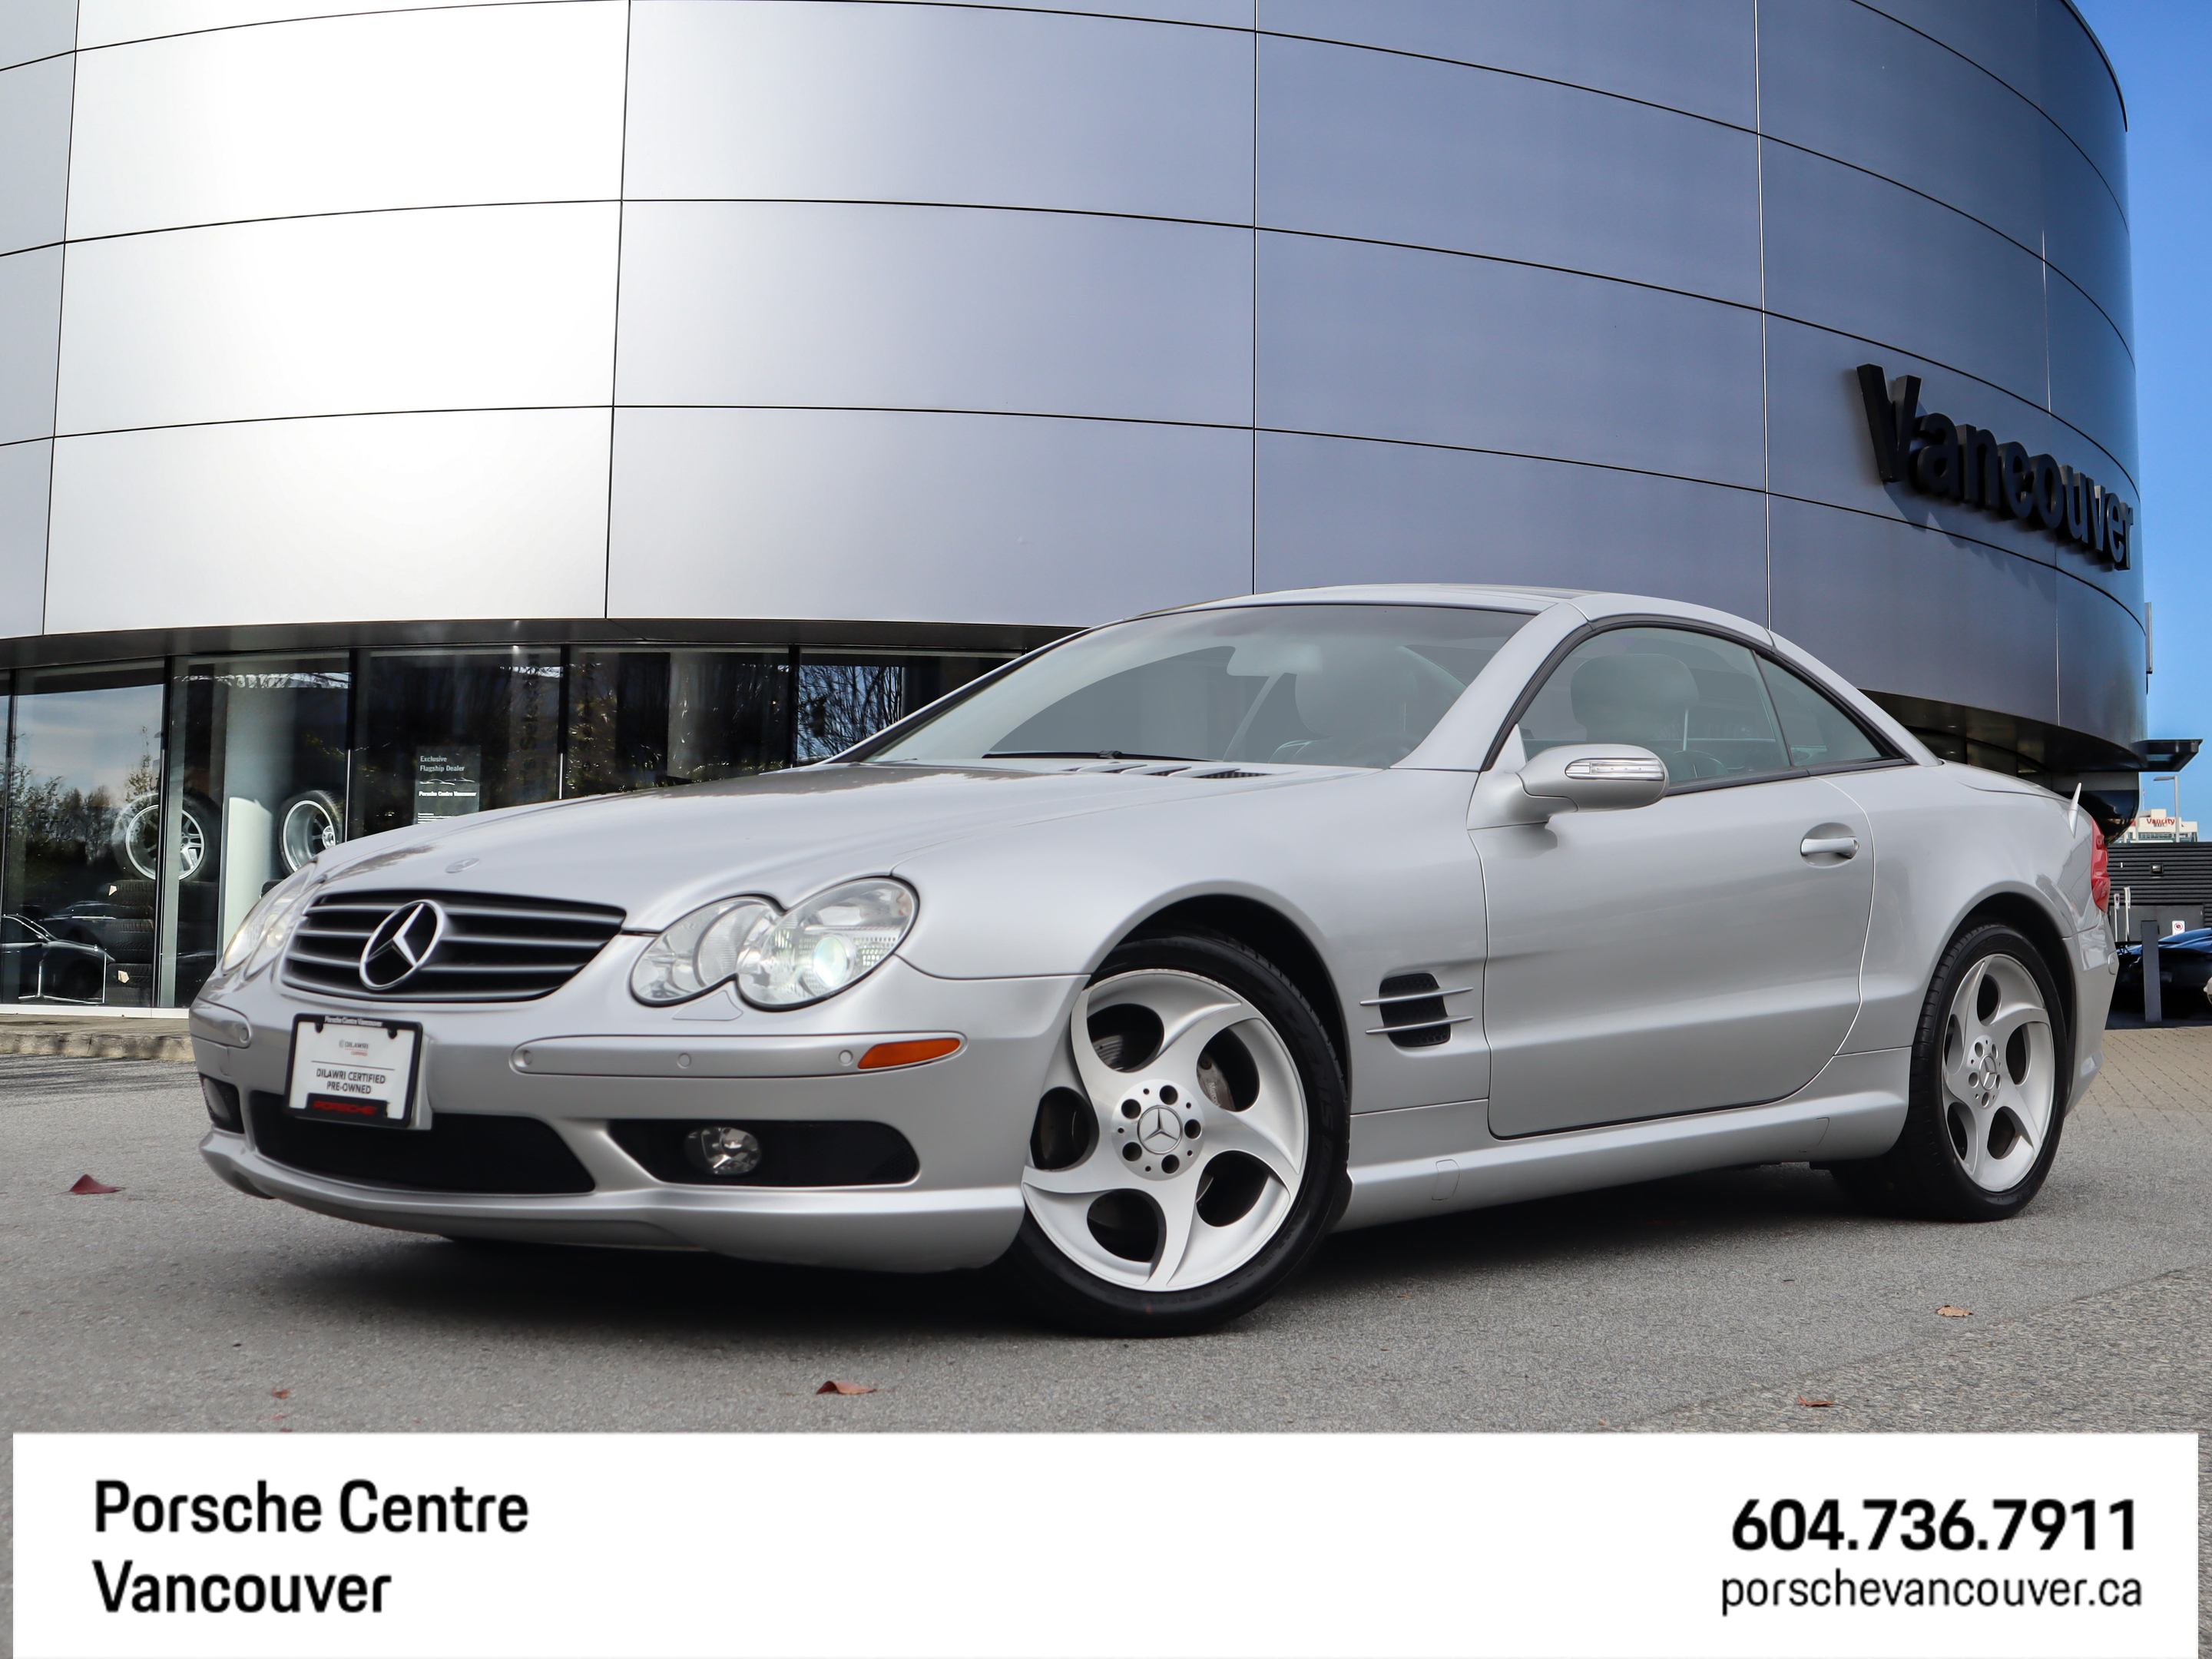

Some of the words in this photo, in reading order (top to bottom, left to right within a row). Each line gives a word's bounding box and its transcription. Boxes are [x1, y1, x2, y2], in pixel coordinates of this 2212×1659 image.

[1856, 363, 2134, 571] Vancouver
[343, 1016, 357, 1025] Centre
[358, 1018, 382, 1027] Vancouver
[316, 1068, 346, 1080] DILAWRI
[348, 1071, 386, 1084] CERTIFIED
[326, 1081, 371, 1094] PRE-OWNED
